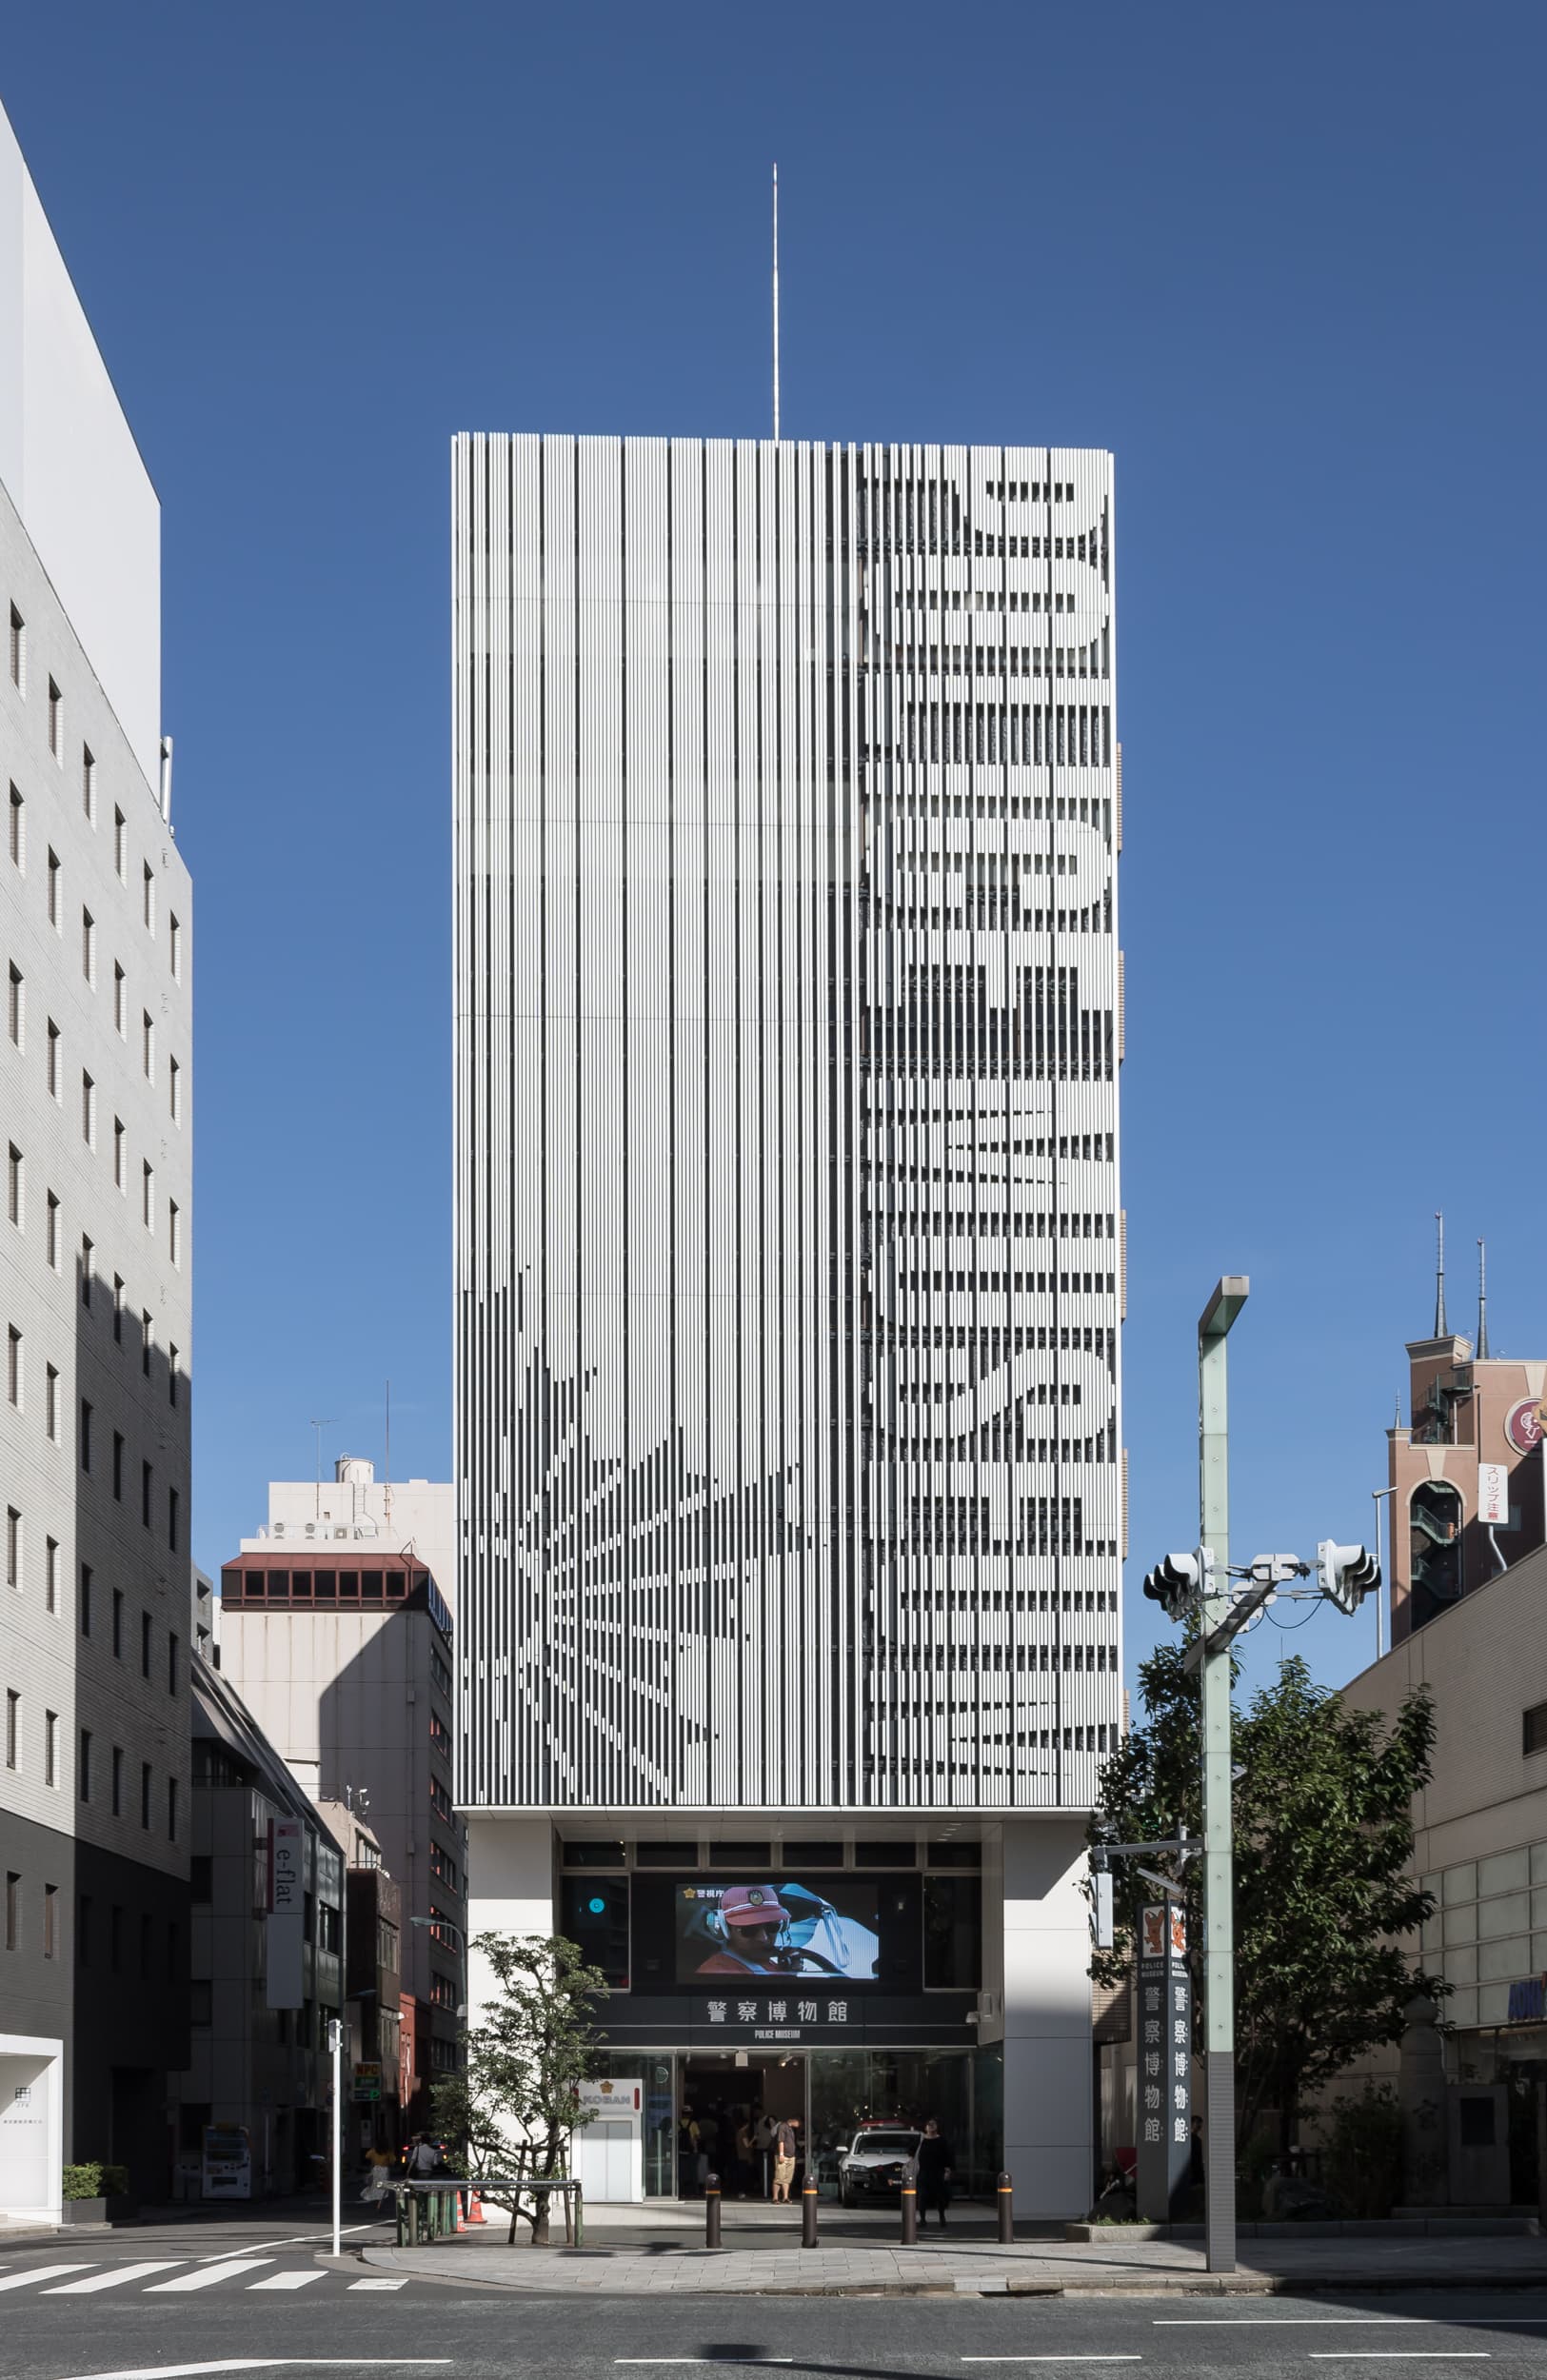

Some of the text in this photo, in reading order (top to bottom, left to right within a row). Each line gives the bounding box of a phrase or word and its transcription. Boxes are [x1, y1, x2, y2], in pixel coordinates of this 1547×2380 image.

[863, 447, 1118, 1804] POLICE MUSEUM
[276, 1849, 296, 1905] e-flat
[707, 2000, 847, 2022] 警察博物館
[754, 2030, 801, 2039] POLICE MUSEUM
[1144, 1986, 1160, 2142] 警察博物館
[1174, 1986, 1186, 2142] 警察博物館
